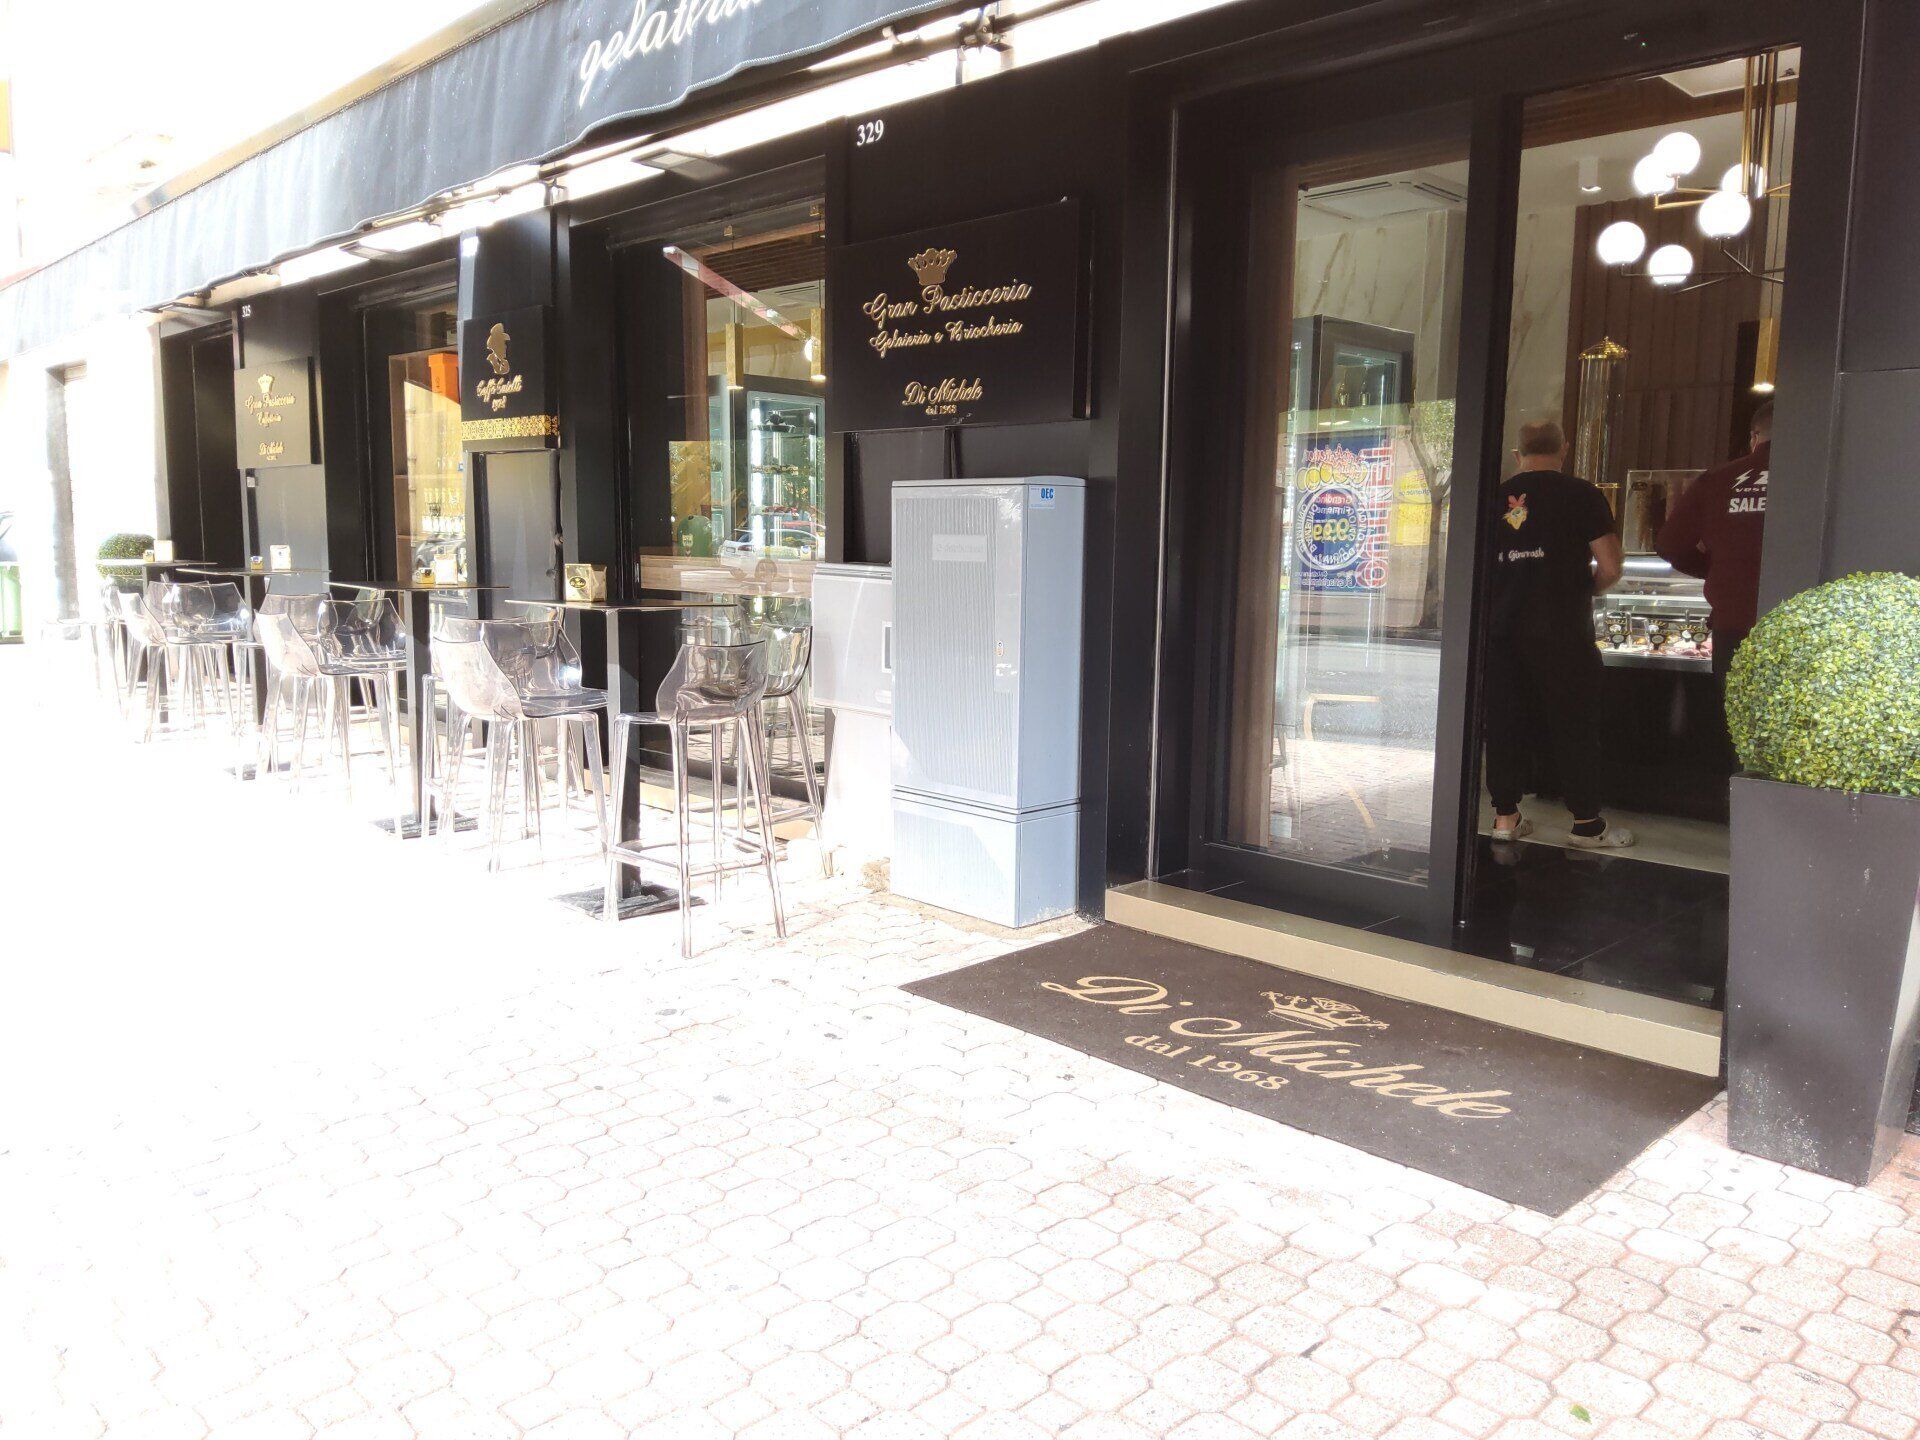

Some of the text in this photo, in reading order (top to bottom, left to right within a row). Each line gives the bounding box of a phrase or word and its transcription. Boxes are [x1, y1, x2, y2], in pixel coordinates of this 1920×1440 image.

[856, 119, 885, 146] 329
[863, 279, 1033, 329] Gran Pasticceria
[869, 315, 1023, 359] Gelateria e Briocheria
[902, 377, 983, 407] Di Michele
[925, 404, 957, 416] dal 1968
[1041, 487, 1054, 500] OEC
[1040, 975, 1512, 1119] Di Michele
[1124, 1033, 1290, 1091] dal 1968
